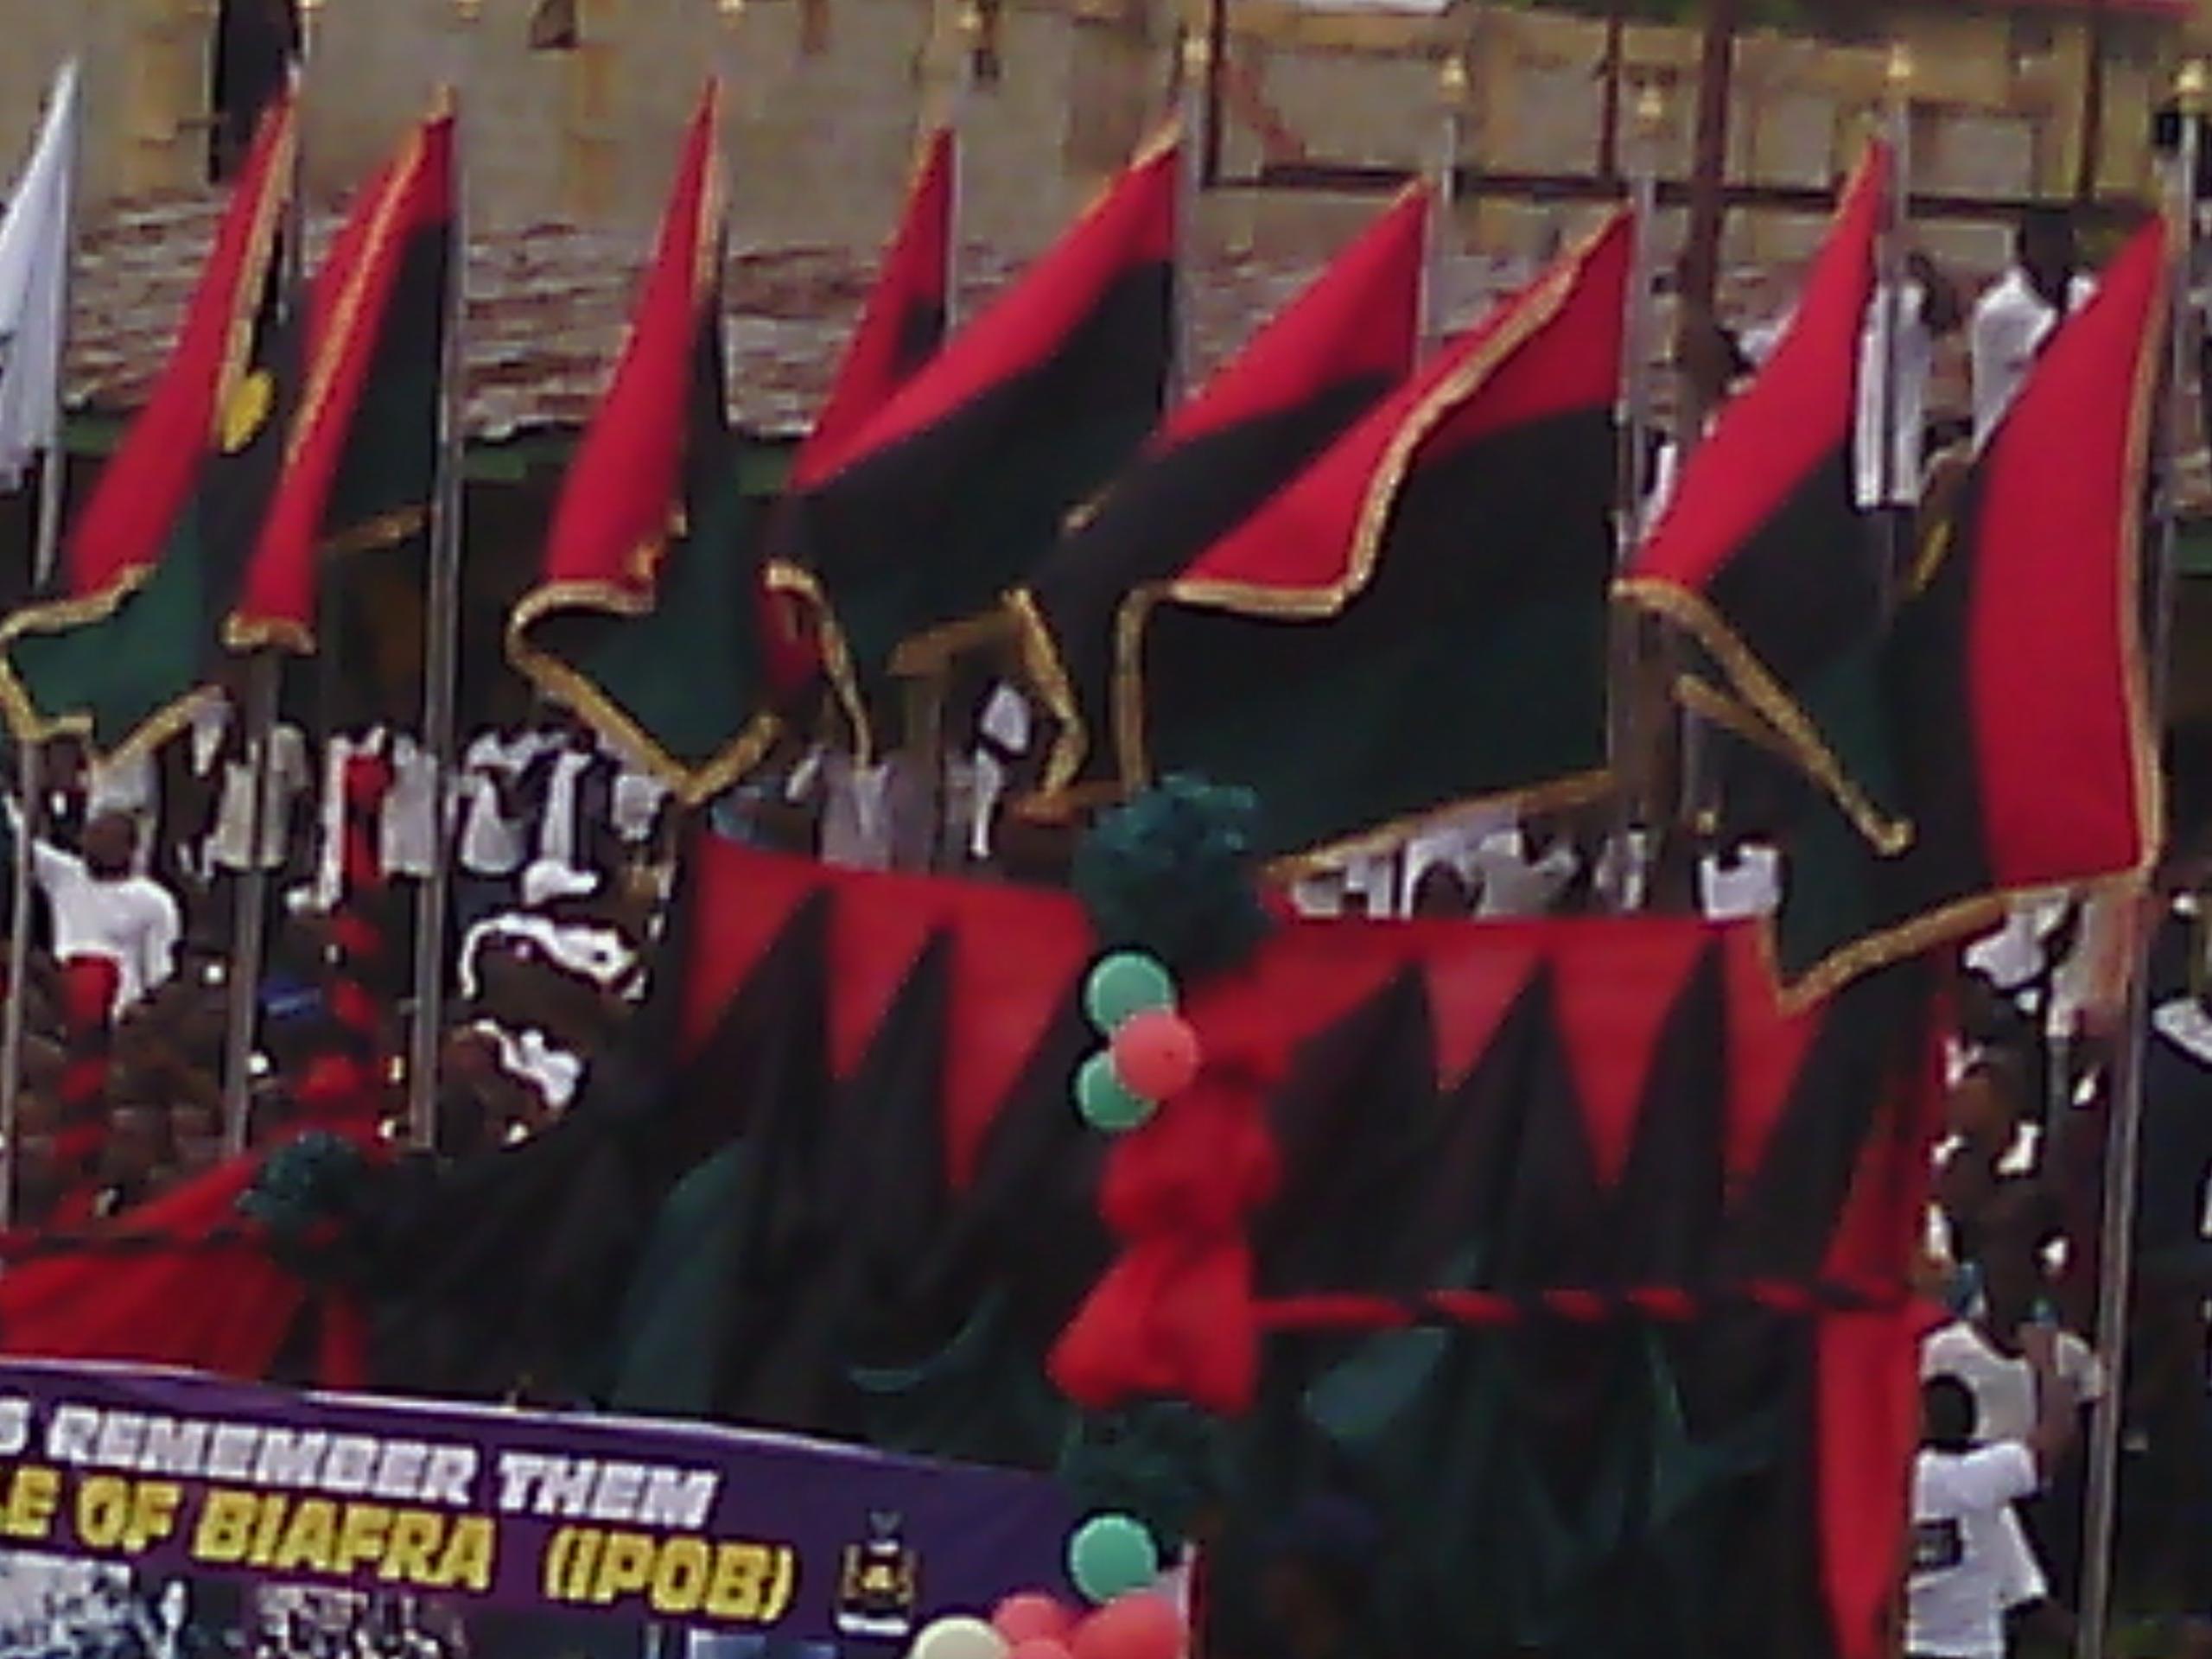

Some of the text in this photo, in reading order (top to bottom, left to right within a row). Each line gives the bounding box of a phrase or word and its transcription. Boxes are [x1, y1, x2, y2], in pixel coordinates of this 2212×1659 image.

[47, 1404, 477, 1505] REMEMBER
[498, 1452, 720, 1529] THEM
[75, 1476, 183, 1553] OF
[192, 1488, 496, 1592] BIAFRA
[544, 1526, 794, 1623] (IPOB)
